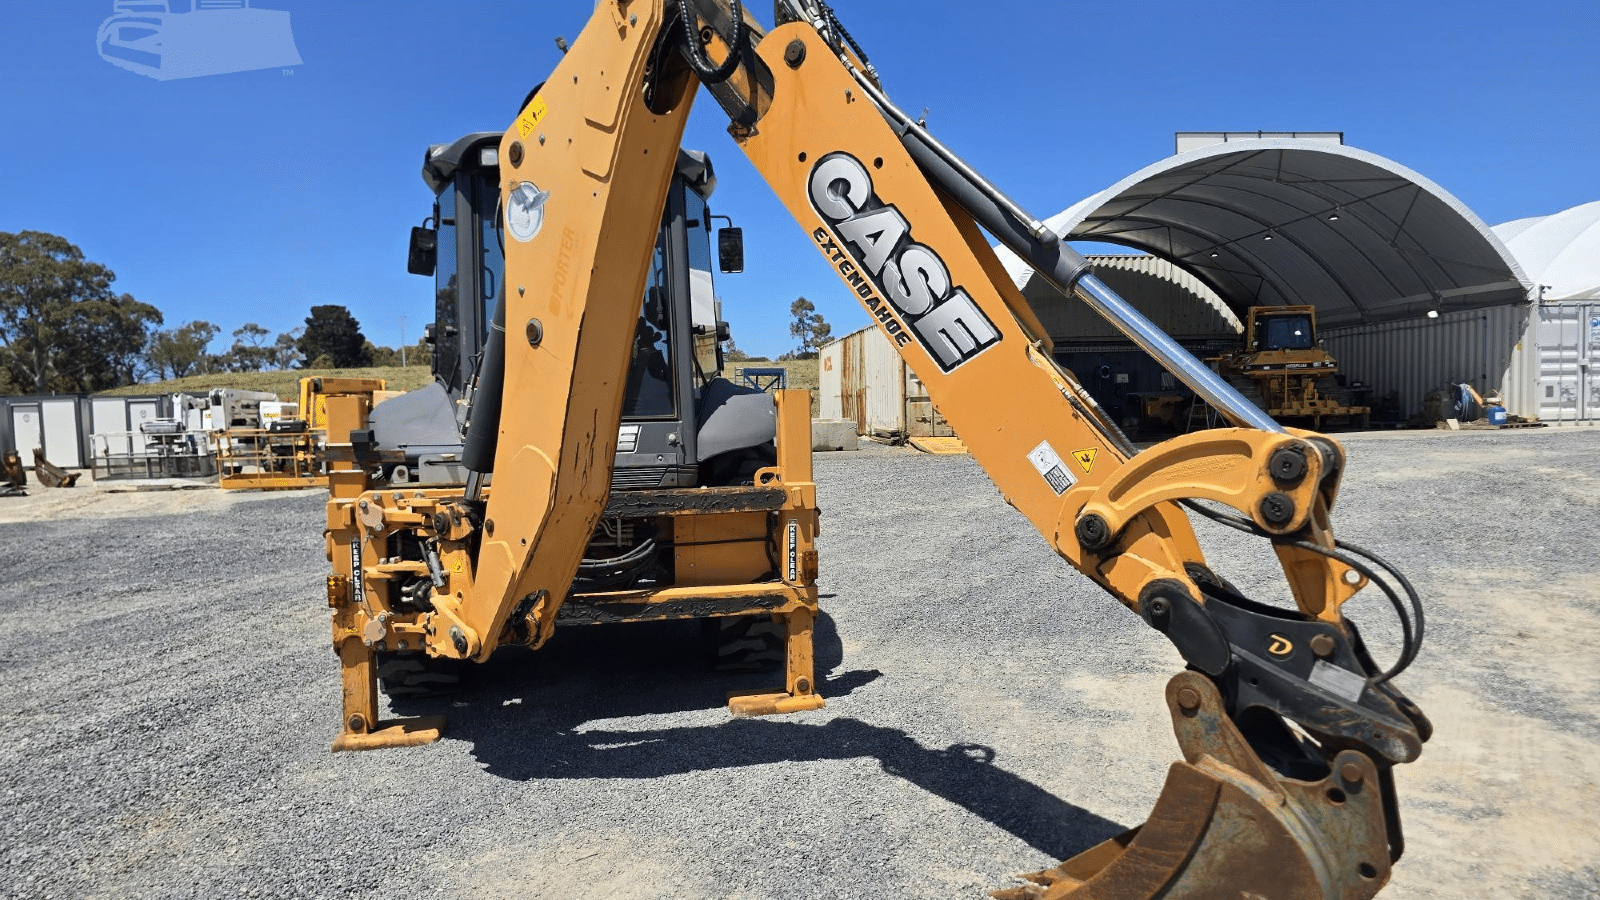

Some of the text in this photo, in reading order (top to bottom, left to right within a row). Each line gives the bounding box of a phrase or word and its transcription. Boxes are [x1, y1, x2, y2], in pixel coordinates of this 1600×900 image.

[808, 151, 1004, 375] CASE
[813, 227, 912, 348] EXTENDAHOE
[352, 542, 362, 602] KEEP CLEAR
